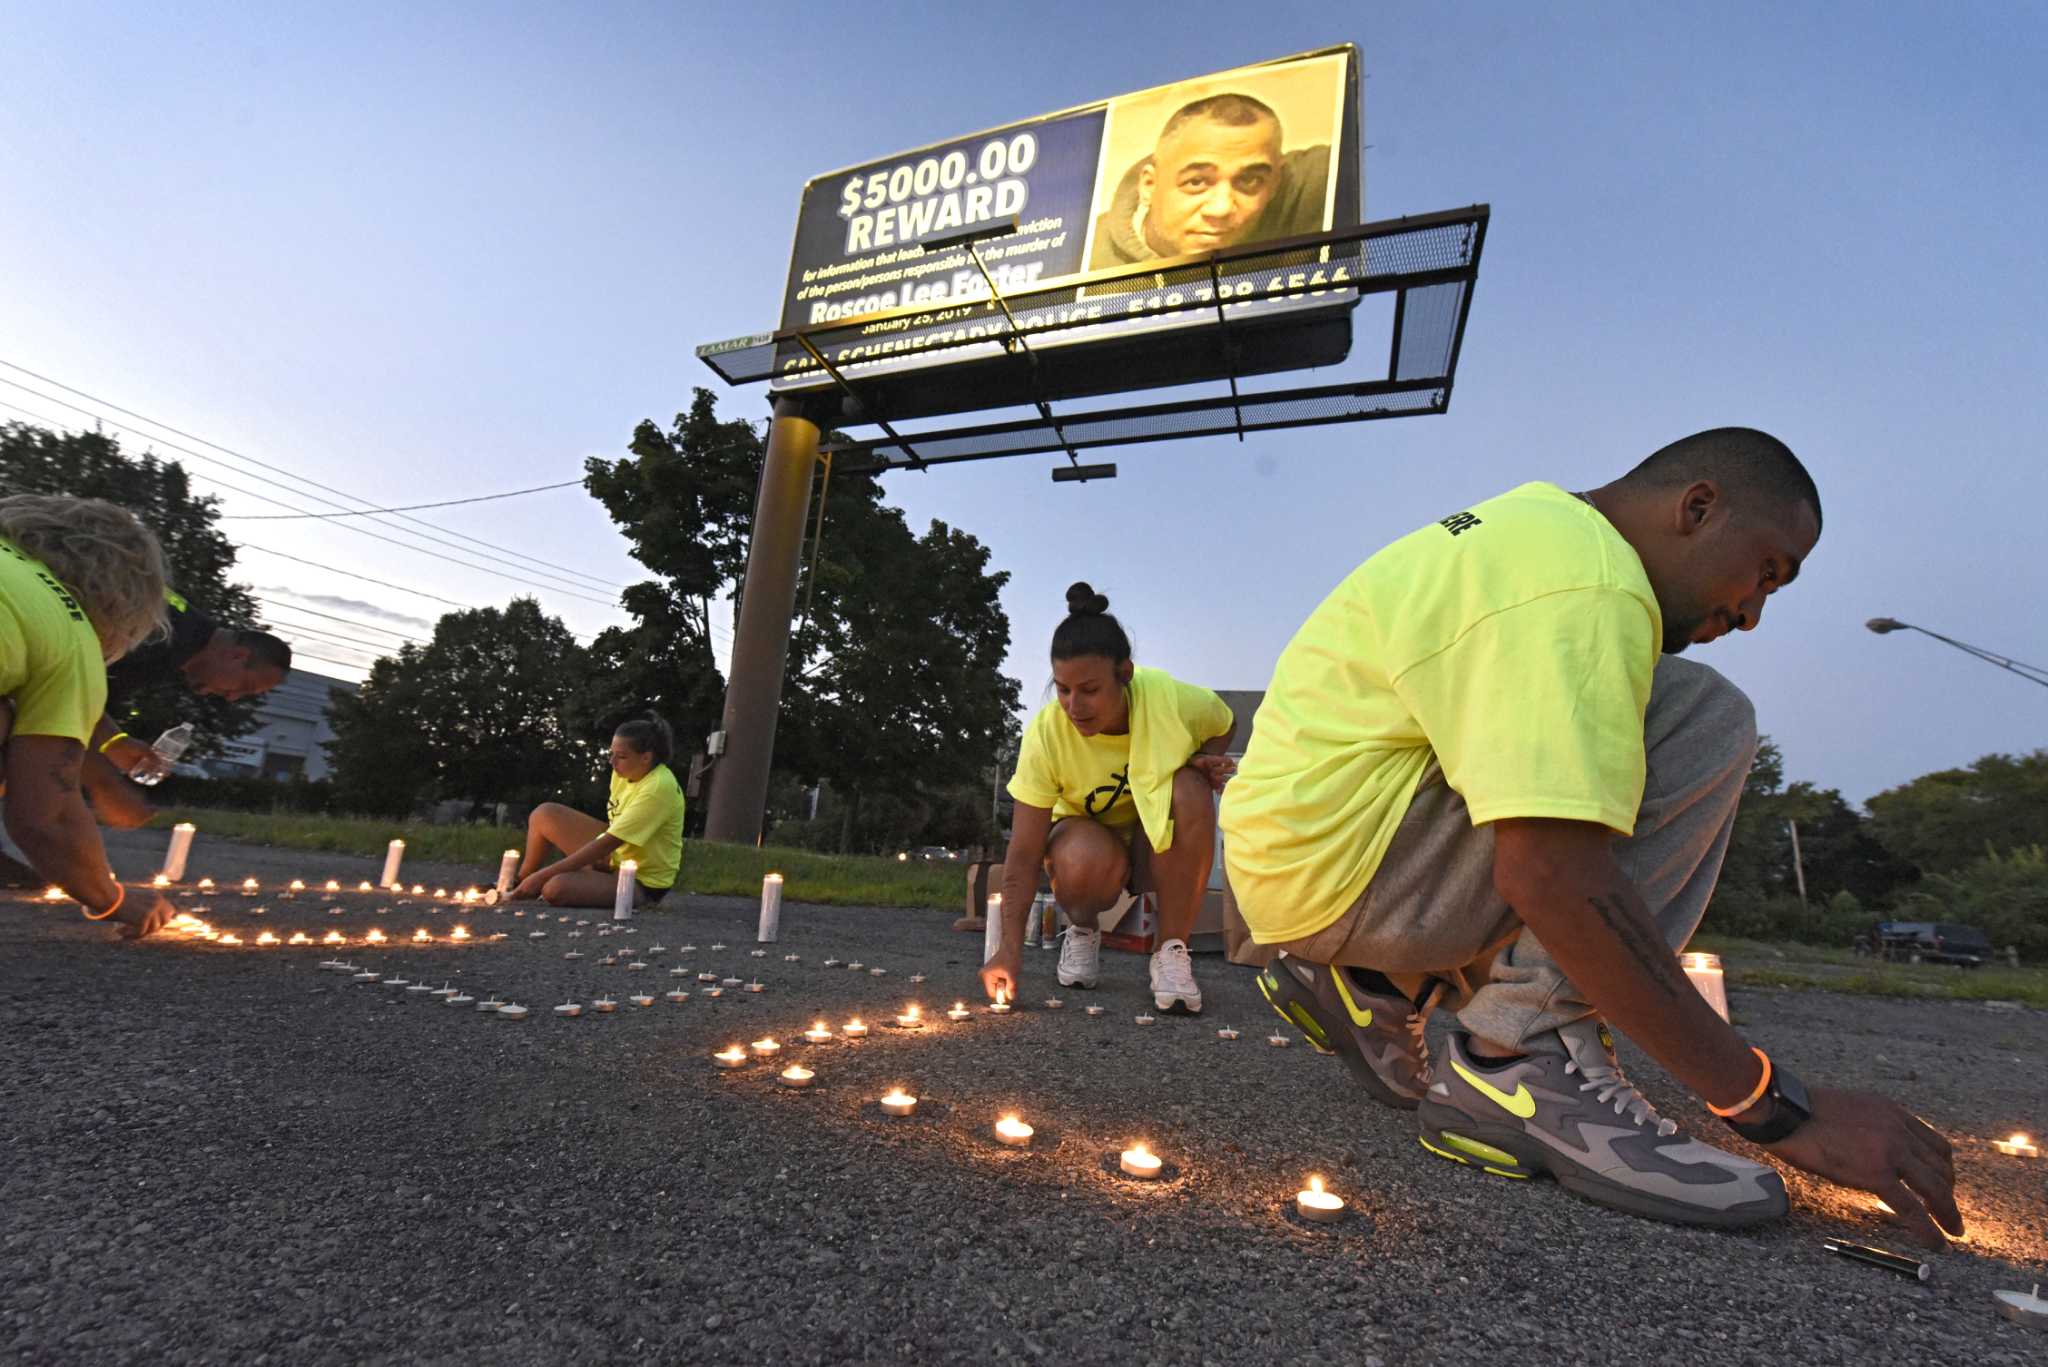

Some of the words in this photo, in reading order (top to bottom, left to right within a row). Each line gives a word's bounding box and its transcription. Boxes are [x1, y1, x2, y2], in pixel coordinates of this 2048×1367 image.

[841, 134, 1036, 216] $5000.00
[847, 179, 1026, 252] REWARD
[797, 286, 809, 300] of
[808, 285, 825, 298] the
[824, 268, 903, 298] person/persons
[903, 253, 966, 278] responsible
[984, 245, 1004, 261] the
[1005, 238, 1050, 257] murder
[1051, 232, 1067, 248] of
[802, 270, 817, 283] for
[817, 258, 875, 279] information
[875, 252, 897, 266] that
[897, 243, 925, 261] leads
[1003, 220, 1063, 239] nviction
[810, 290, 897, 325] Roscoe
[901, 279, 949, 308] Lee
[862, 317, 911, 336] January
